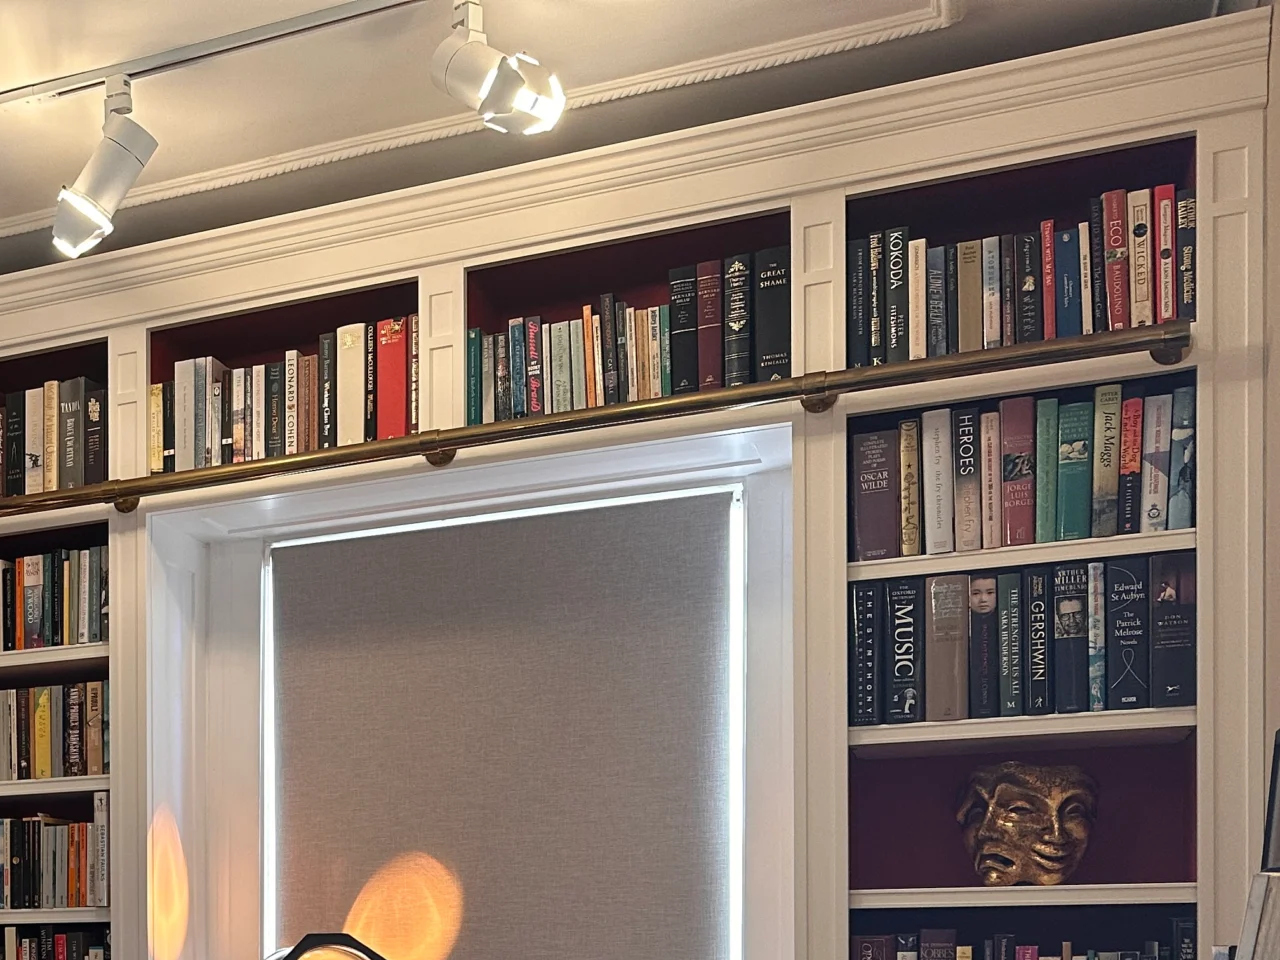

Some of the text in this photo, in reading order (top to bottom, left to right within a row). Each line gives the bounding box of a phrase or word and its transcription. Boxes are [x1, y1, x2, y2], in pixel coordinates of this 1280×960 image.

[1178, 200, 1187, 230] HAILEY
[1109, 219, 1122, 246] ECO
[890, 231, 903, 290] KOKODA
[1136, 238, 1147, 286] WICKED
[760, 268, 786, 279] GREAT
[987, 250, 996, 297] ATONEMENT
[1180, 245, 1194, 304] Strong Medicine
[759, 278, 787, 289] SHAME
[1113, 264, 1123, 315] BAUDOLINO
[671, 292, 696, 300] BERNARD
[698, 288, 721, 296] BERNARD
[897, 314, 905, 336] PETER
[528, 321, 539, 359] Russell
[760, 358, 789, 367] KENEALLY
[762, 352, 788, 360] THOMAS
[287, 358, 295, 448] LEONARD COHEN
[271, 394, 280, 434] Homo Deus
[323, 408, 331, 424] Class
[31, 420, 39, 450] IRVING
[323, 424, 331, 436] Boy
[959, 414, 974, 476] HEROES
[1099, 411, 1116, 468] Jack Maggs
[860, 471, 889, 482] OSCAR
[861, 480, 889, 491] WILDE
[1006, 483, 1032, 493] JORGE
[1010, 491, 1028, 501] LUIS
[935, 494, 943, 530] chronicles
[1054, 575, 1087, 585] MILLER
[1114, 582, 1143, 592] Edward
[1011, 588, 1019, 606] THE
[1111, 591, 1146, 602] St Aubyn
[1011, 607, 1019, 652] STRENGTH
[1116, 618, 1142, 628] Patrick
[894, 602, 914, 677] MUSIC
[1031, 600, 1045, 681] GERSHWIN
[1114, 628, 1143, 637] Melrose
[1001, 610, 1009, 676] SARA HENDERSON
[1119, 638, 1138, 646] Novels
[1011, 655, 1019, 665] IN
[1012, 666, 1019, 678] US
[1006, 701, 1016, 709] M
